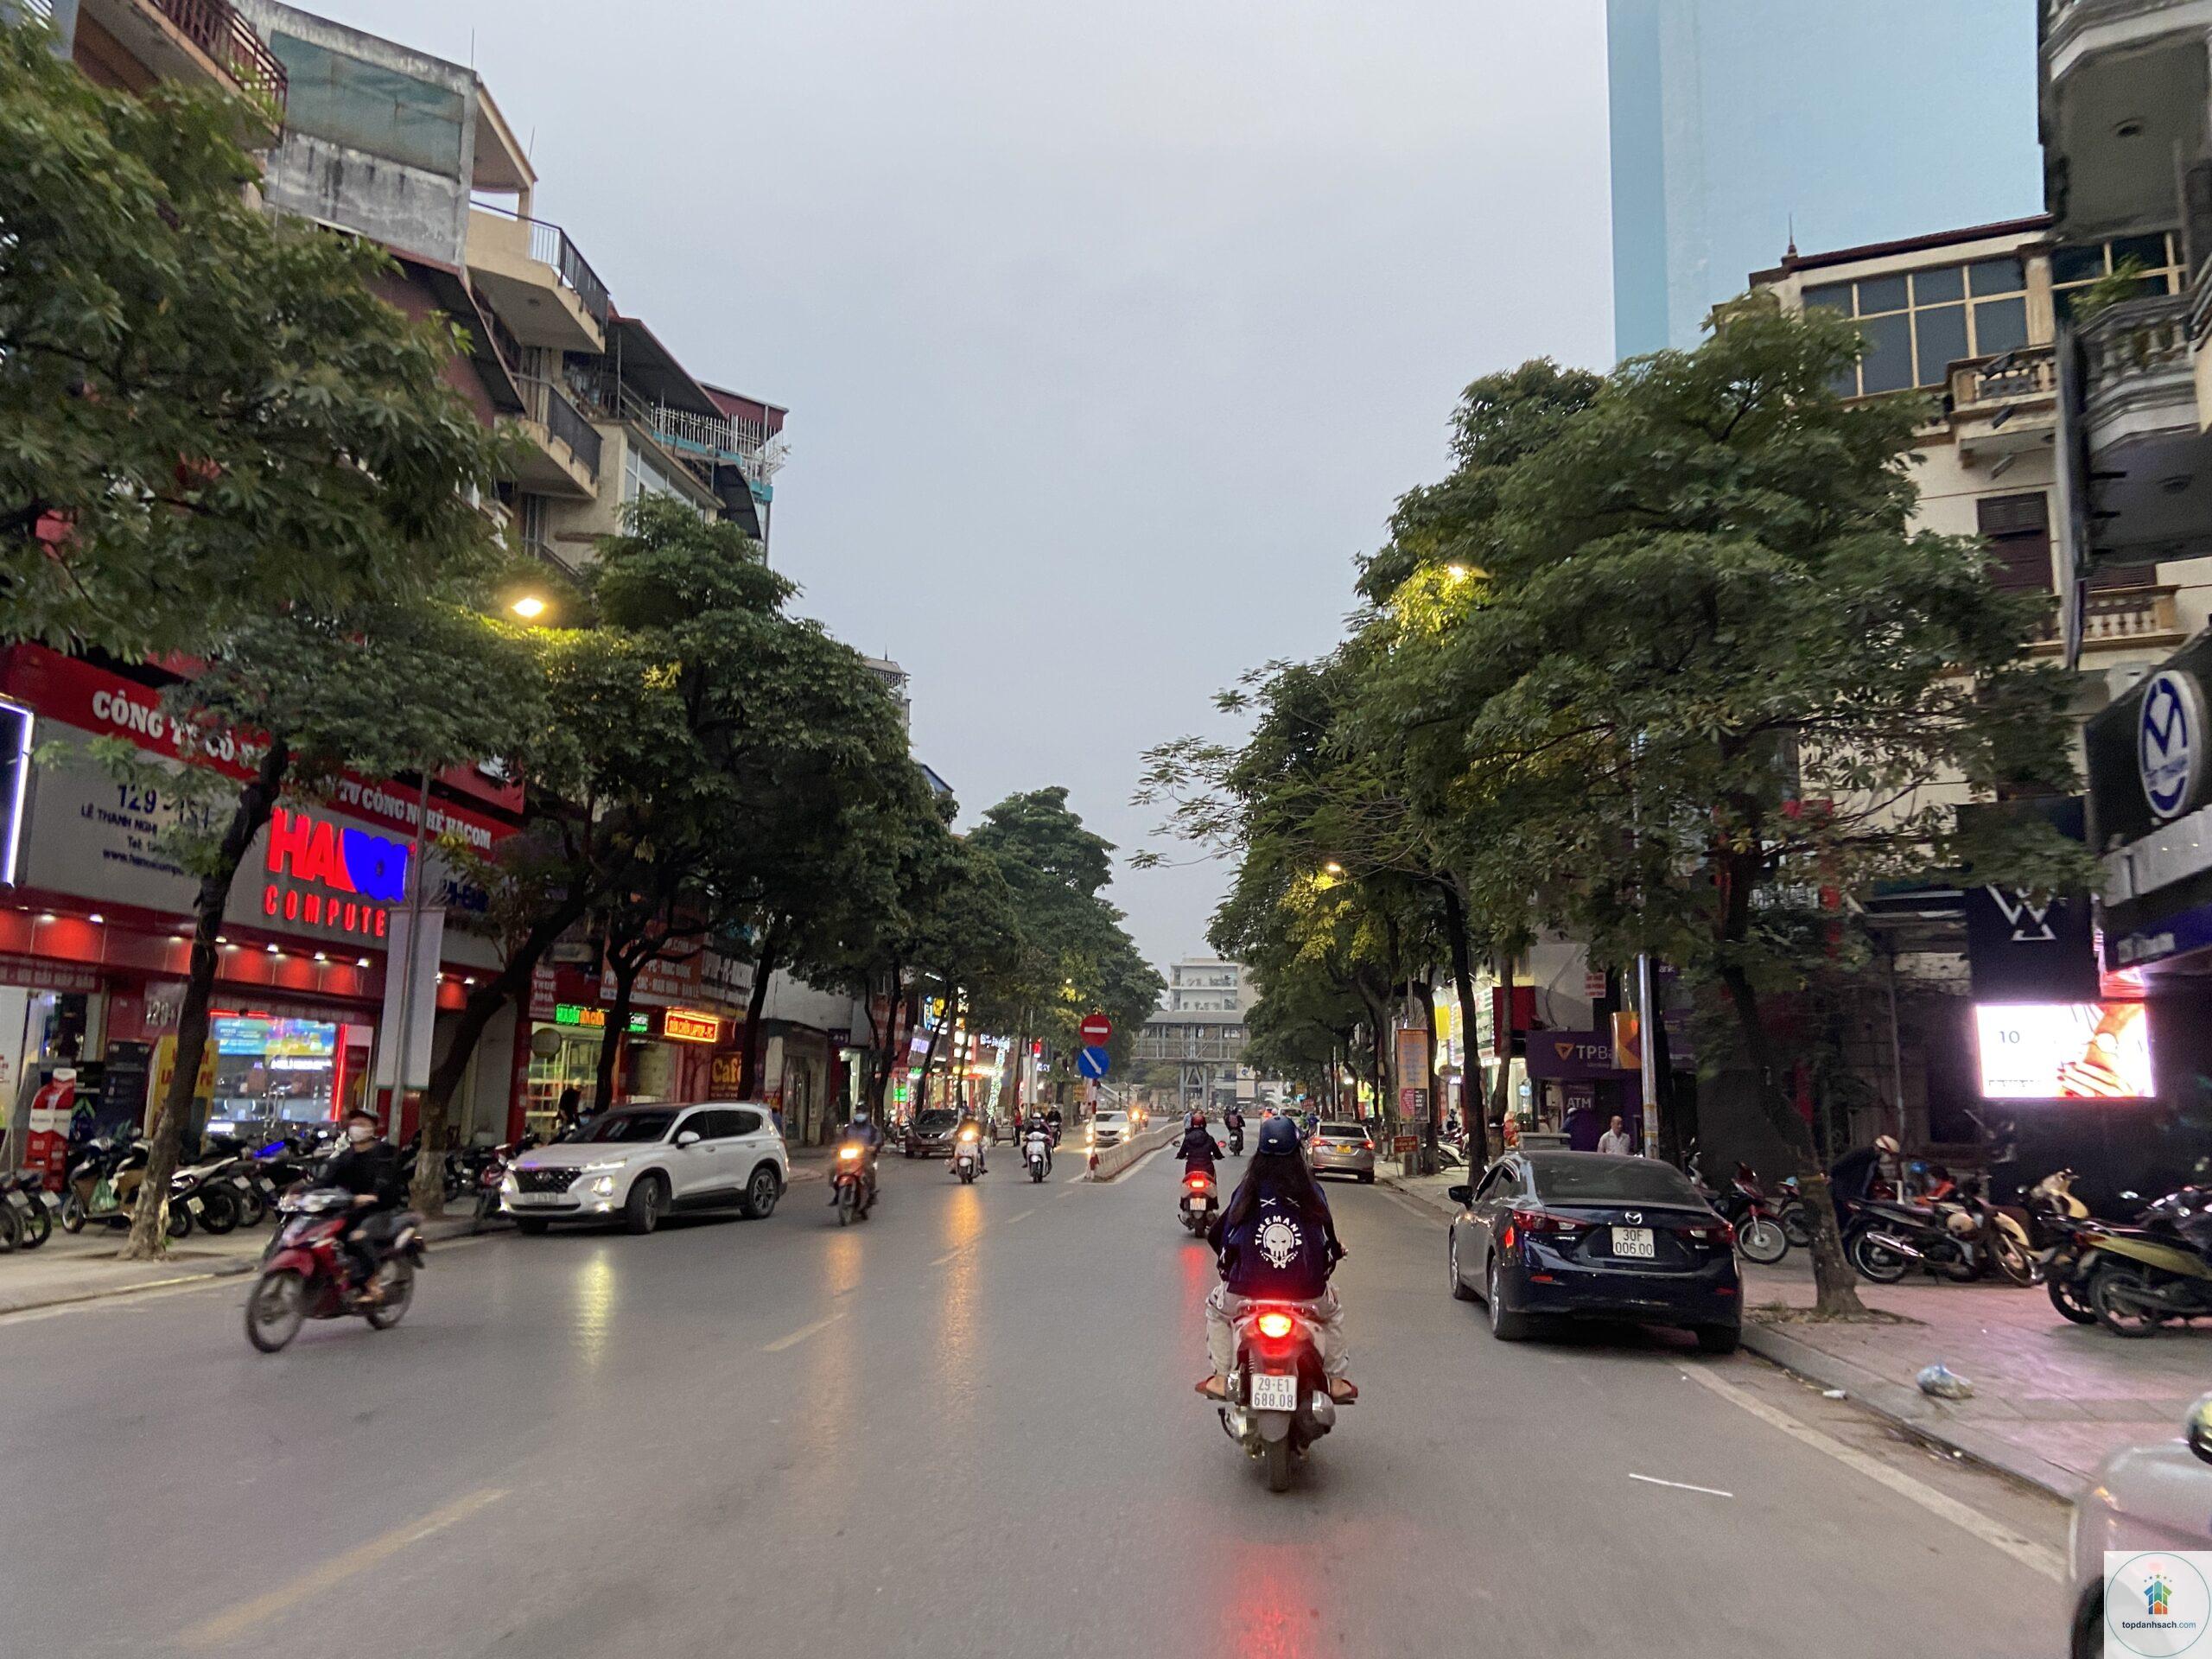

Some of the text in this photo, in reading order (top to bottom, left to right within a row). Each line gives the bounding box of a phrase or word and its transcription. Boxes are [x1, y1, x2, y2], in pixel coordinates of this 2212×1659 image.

[92, 690, 163, 739] CÔNG
[362, 787, 405, 820] CÔNG
[264, 884, 386, 938] COMPUTE
[1999, 1031, 2020, 1044] 10
[1567, 1097, 1592, 1109] ATM
[1255, 1215, 1302, 1246] TIMEMANIA
[1624, 1229, 1643, 1242] 30F
[1254, 1392, 1294, 1408] 688.08
